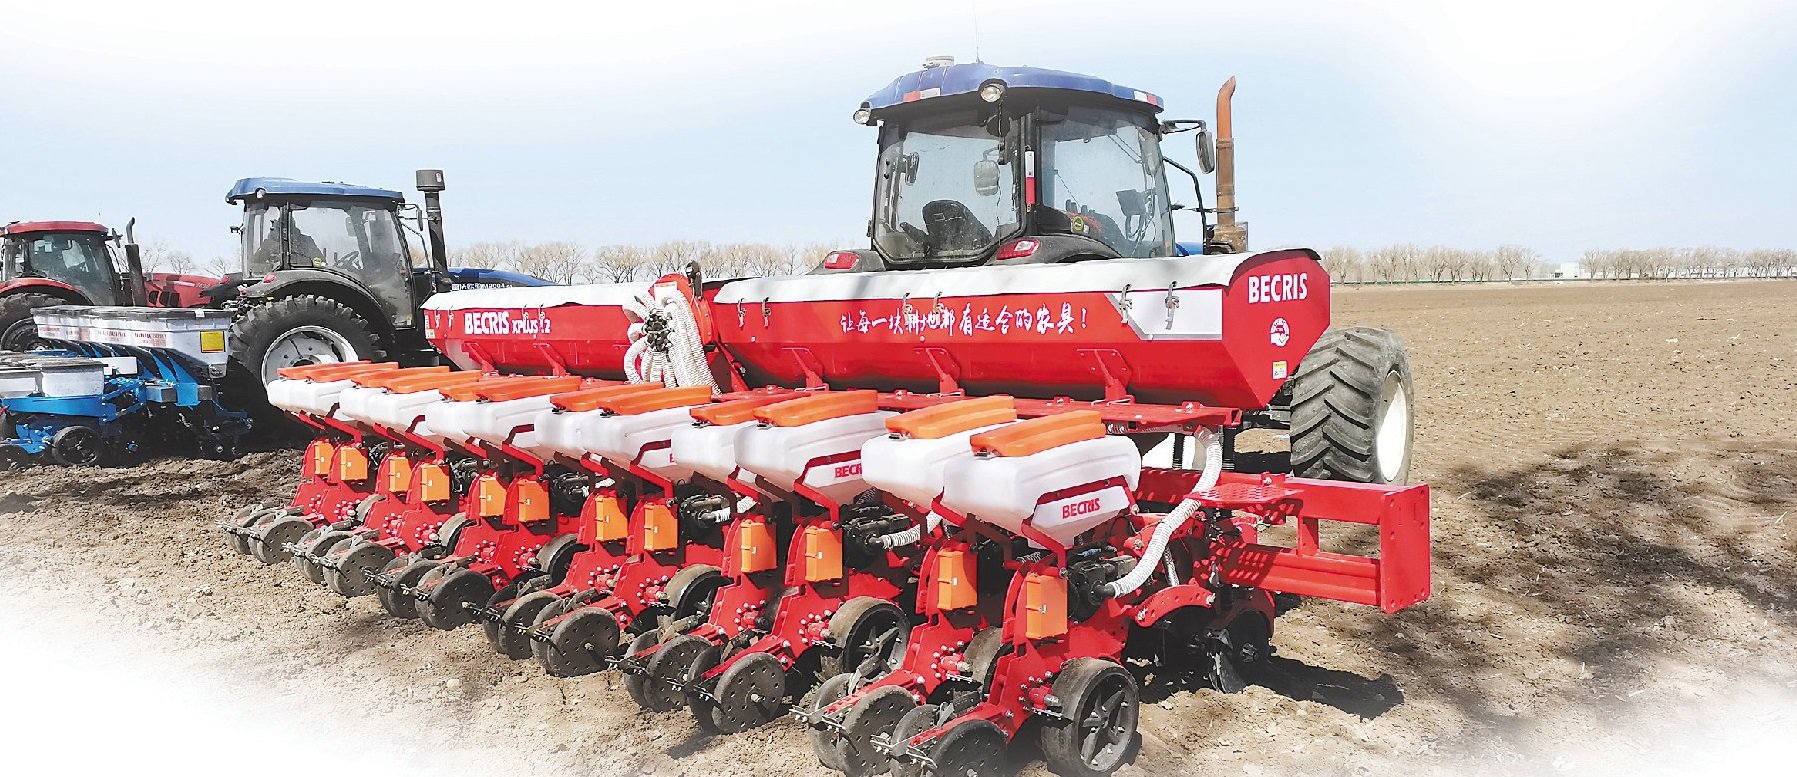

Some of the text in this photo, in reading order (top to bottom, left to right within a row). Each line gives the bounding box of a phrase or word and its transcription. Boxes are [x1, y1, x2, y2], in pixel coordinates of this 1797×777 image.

[1248, 272, 1308, 304] BECRIS
[464, 311, 510, 335] BECRIS
[835, 463, 862, 478] BECR
[1062, 498, 1101, 520] BECRIS
